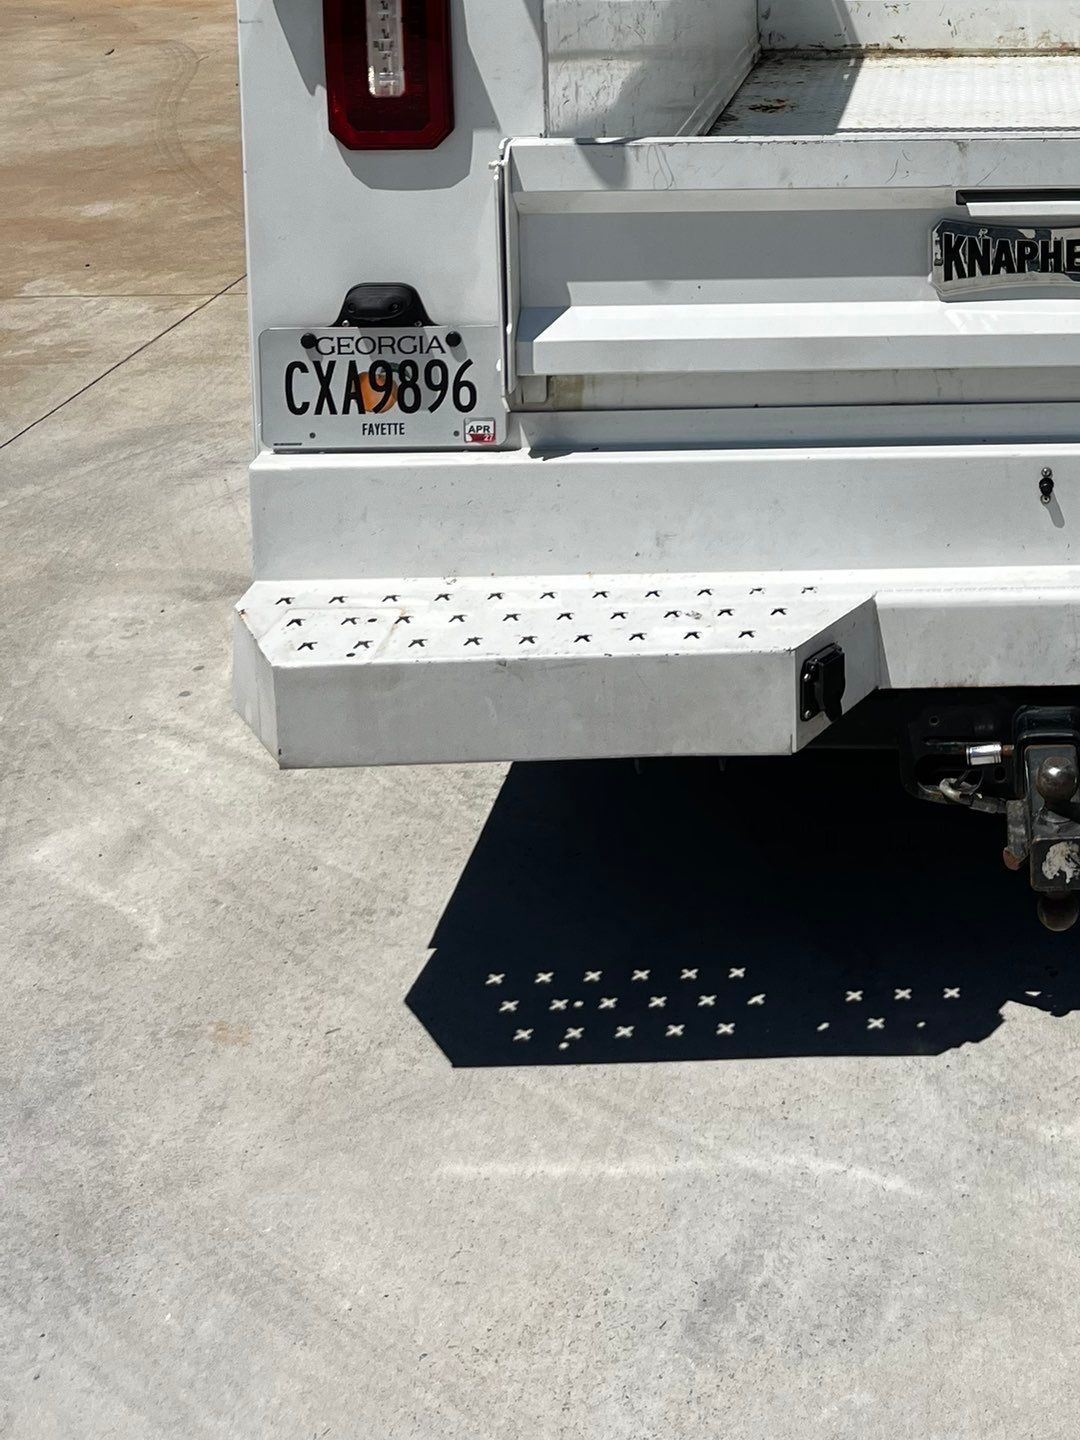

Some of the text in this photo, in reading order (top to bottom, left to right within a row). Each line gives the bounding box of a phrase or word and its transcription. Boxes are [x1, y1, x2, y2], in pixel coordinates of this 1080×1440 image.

[315, 335, 447, 356] GEORGIA
[284, 358, 479, 416] CXA9896
[361, 422, 406, 436] FAYETTE
[467, 424, 491, 435] APR
